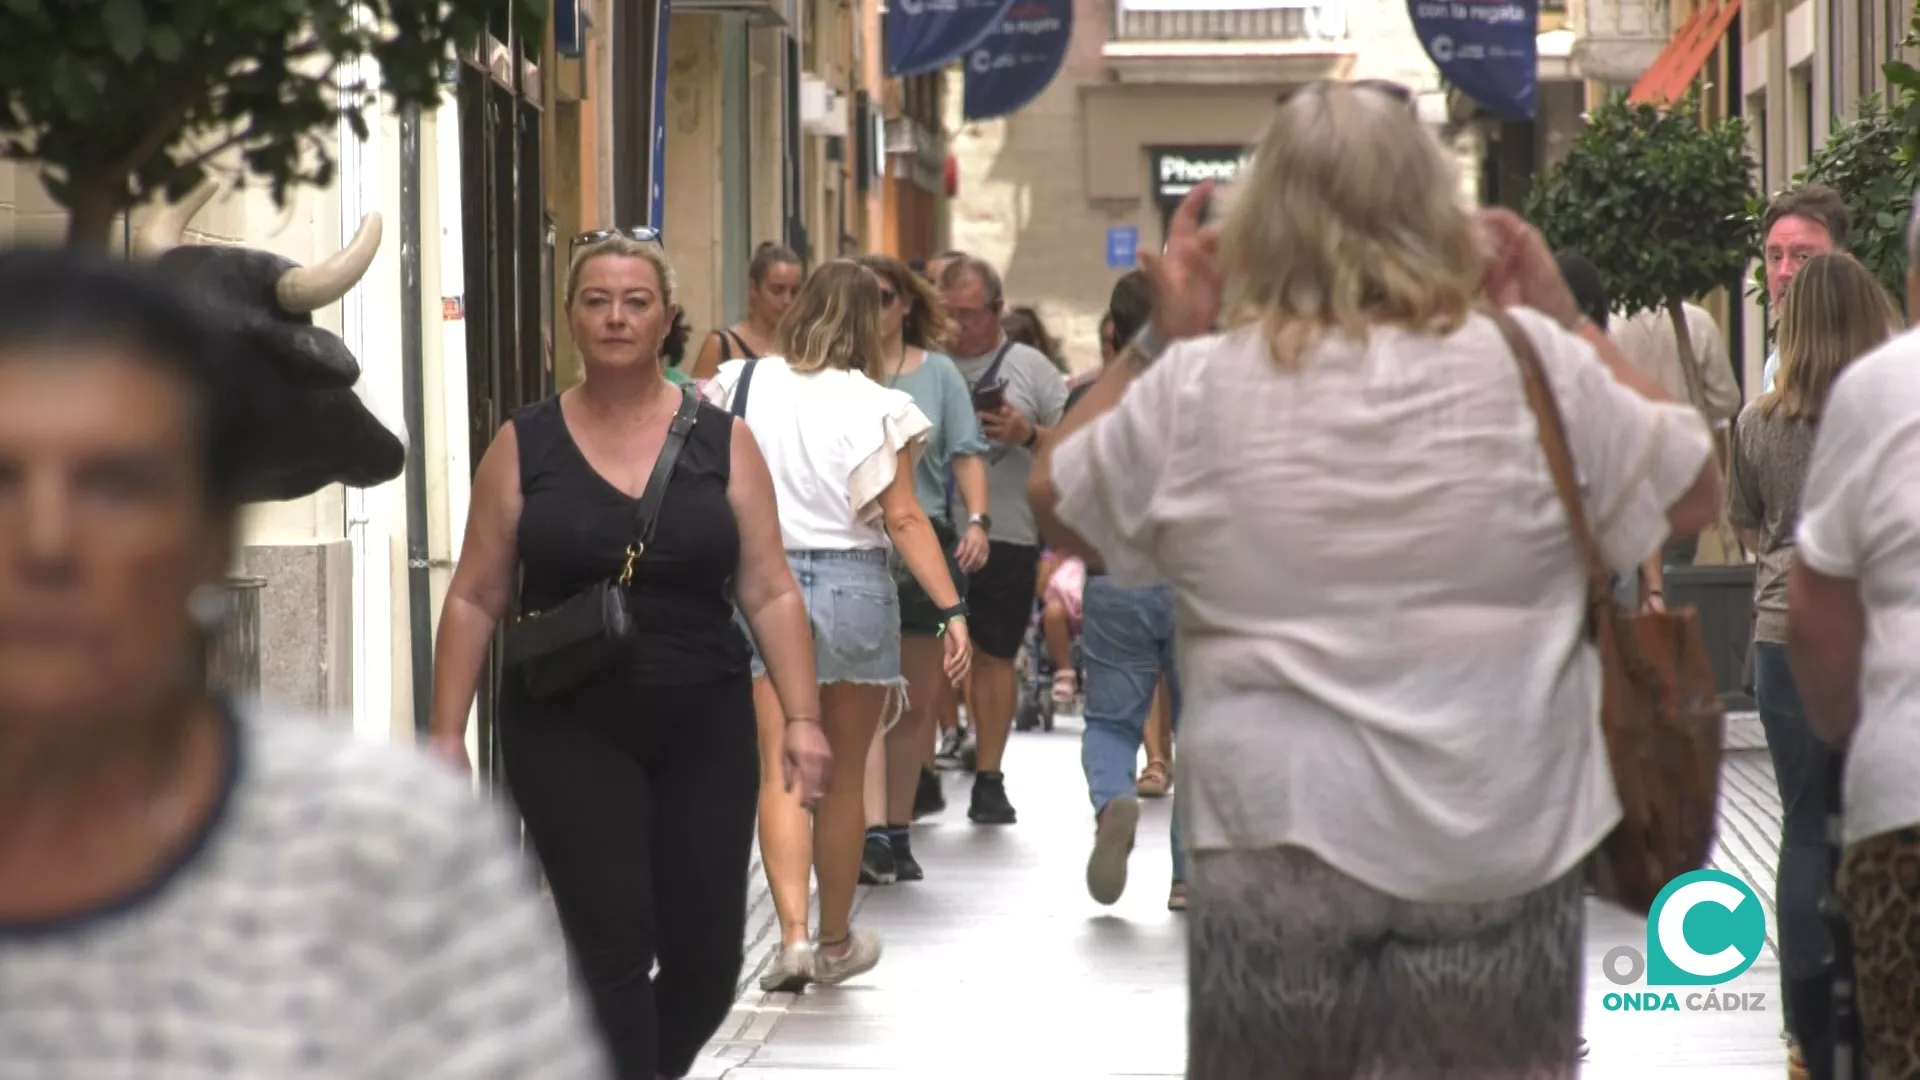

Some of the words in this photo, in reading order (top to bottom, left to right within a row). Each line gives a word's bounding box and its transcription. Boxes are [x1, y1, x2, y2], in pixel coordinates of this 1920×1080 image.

[1418, 3, 1448, 18] con
[1450, 3, 1467, 18] la
[1469, 3, 1525, 23] regata
